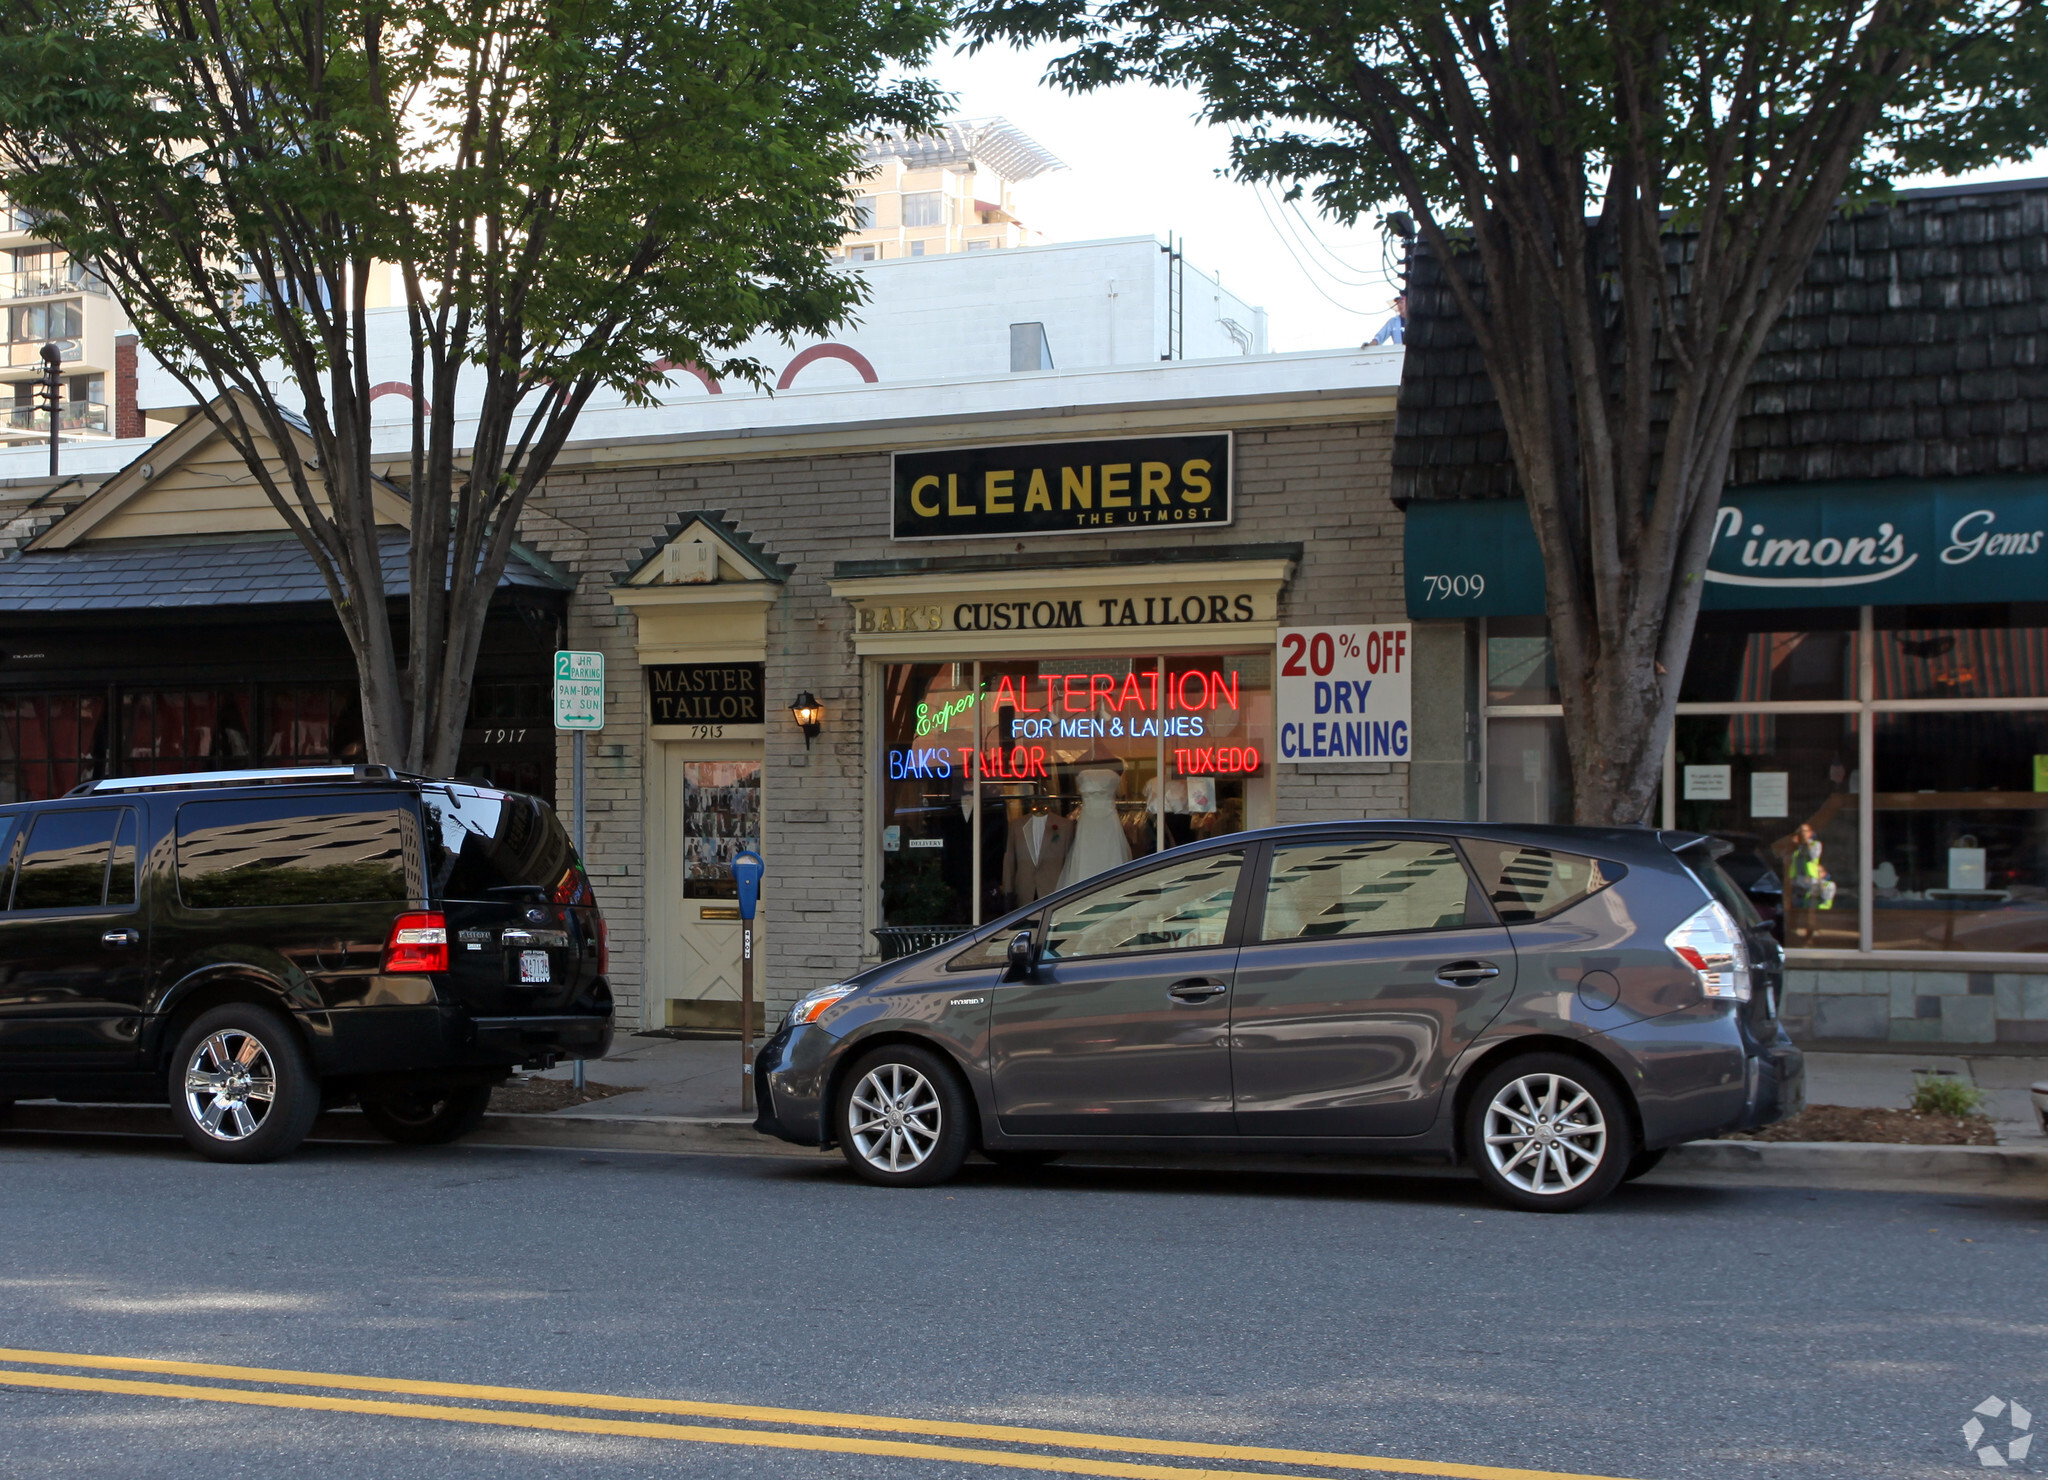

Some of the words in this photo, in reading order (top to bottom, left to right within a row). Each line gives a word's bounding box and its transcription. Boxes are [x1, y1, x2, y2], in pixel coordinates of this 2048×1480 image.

[910, 458, 1212, 517] CLEANERS
[1077, 511, 1114, 525] THE
[1128, 507, 1212, 523] UTMOST
[1940, 510, 2045, 565] Gems
[1423, 574, 1485, 600] 7909
[858, 606, 943, 632] BAK'S
[953, 601, 1086, 630] CUSTOM
[1099, 594, 1254, 626] TAILORS
[1366, 630, 1407, 675] OFF
[558, 656, 570, 676] 2
[579, 656, 592, 666] HR
[571, 667, 600, 678] PARKING
[559, 685, 600, 697] 9AM-10PM
[653, 669, 755, 692] MASTER
[992, 670, 1239, 713] ALTERATION
[560, 699, 572, 710] EX
[579, 700, 600, 710] SUN
[657, 696, 758, 719] TAILOR
[1314, 680, 1372, 714] DRY
[484, 728, 526, 744] 7917
[691, 725, 723, 740] 7913
[1011, 718, 1053, 738] FOR
[1060, 718, 1105, 738] MEN
[1109, 716, 1124, 737] &
[1281, 720, 1408, 758] CLEANING
[889, 747, 951, 780] BAK'S
[1173, 746, 1259, 775] TUXEDO
